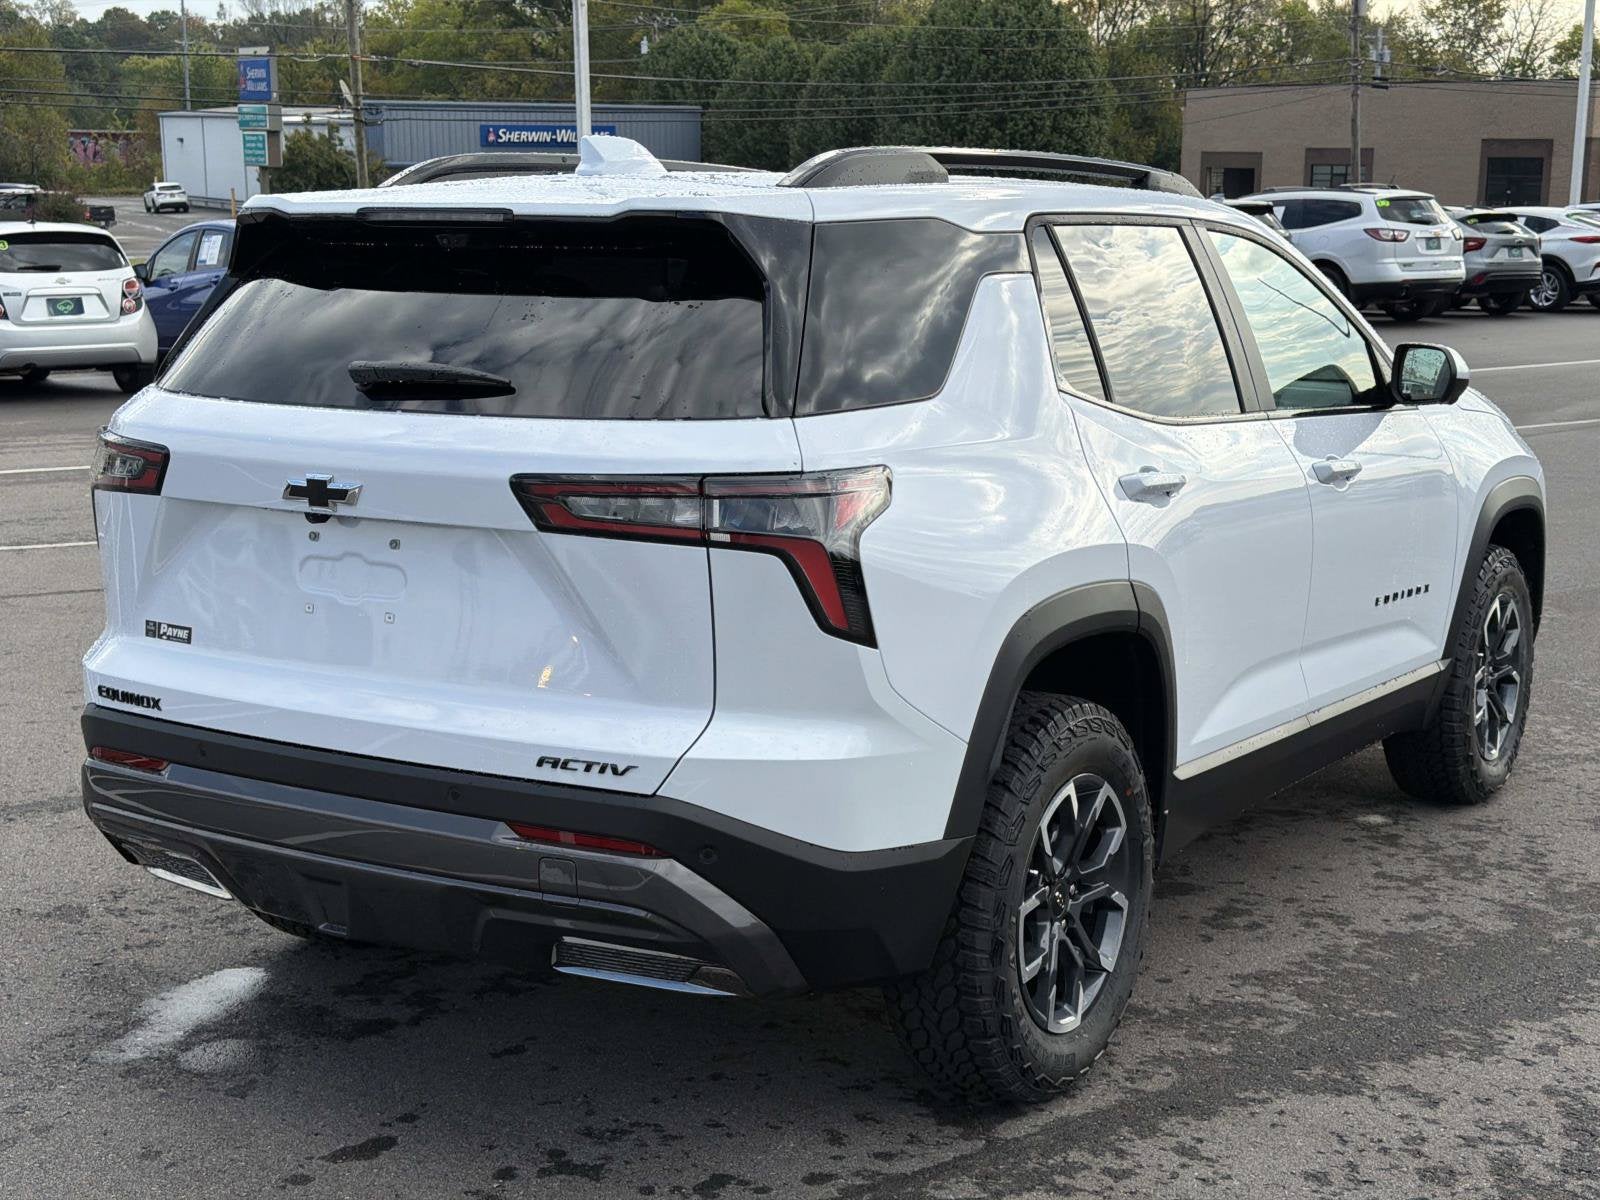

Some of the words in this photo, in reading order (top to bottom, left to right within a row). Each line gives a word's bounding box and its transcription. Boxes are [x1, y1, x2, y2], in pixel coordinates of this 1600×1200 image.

[497, 128, 610, 143] SHERWIN-WIL
[160, 623, 190, 640] PAYNE
[97, 684, 162, 711] EQUINOX
[536, 756, 640, 776] ACTIV
